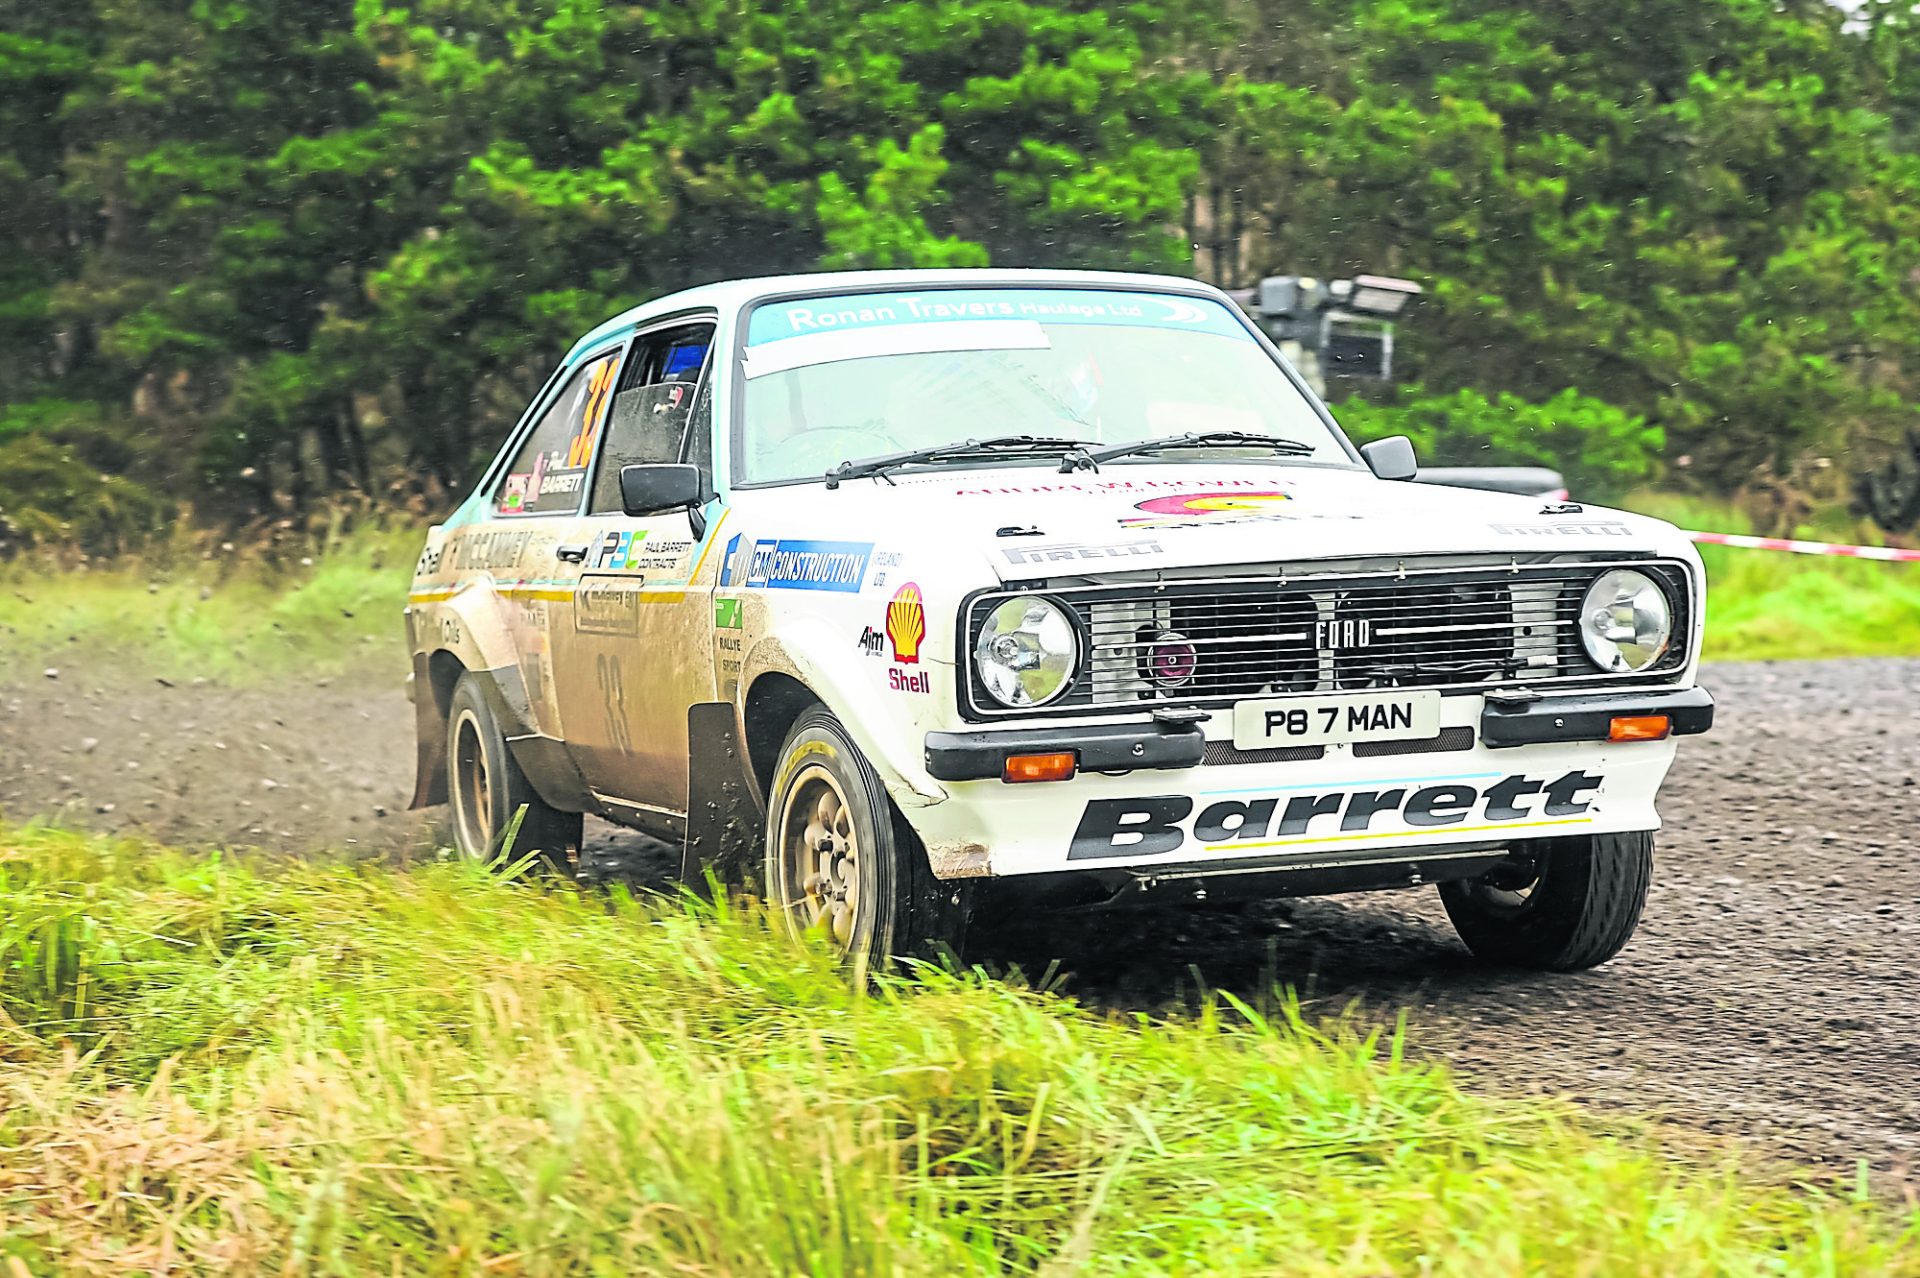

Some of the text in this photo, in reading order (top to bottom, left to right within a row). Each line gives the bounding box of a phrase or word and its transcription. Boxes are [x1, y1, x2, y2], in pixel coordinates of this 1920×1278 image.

[785, 298, 1143, 331] Ronan Travers Haulage Ltd
[1487, 521, 1633, 536] PIRELLI
[1001, 539, 1165, 565] PIRELLI
[750, 550, 866, 583] CM CONSTRUCTION
[719, 637, 741, 652] RALLYE
[1315, 619, 1370, 650] FORD
[722, 660, 741, 673] SPORT
[888, 667, 930, 693] Shell
[1264, 702, 1412, 737] P8 7 MAN
[1066, 770, 1604, 861] Barrett
